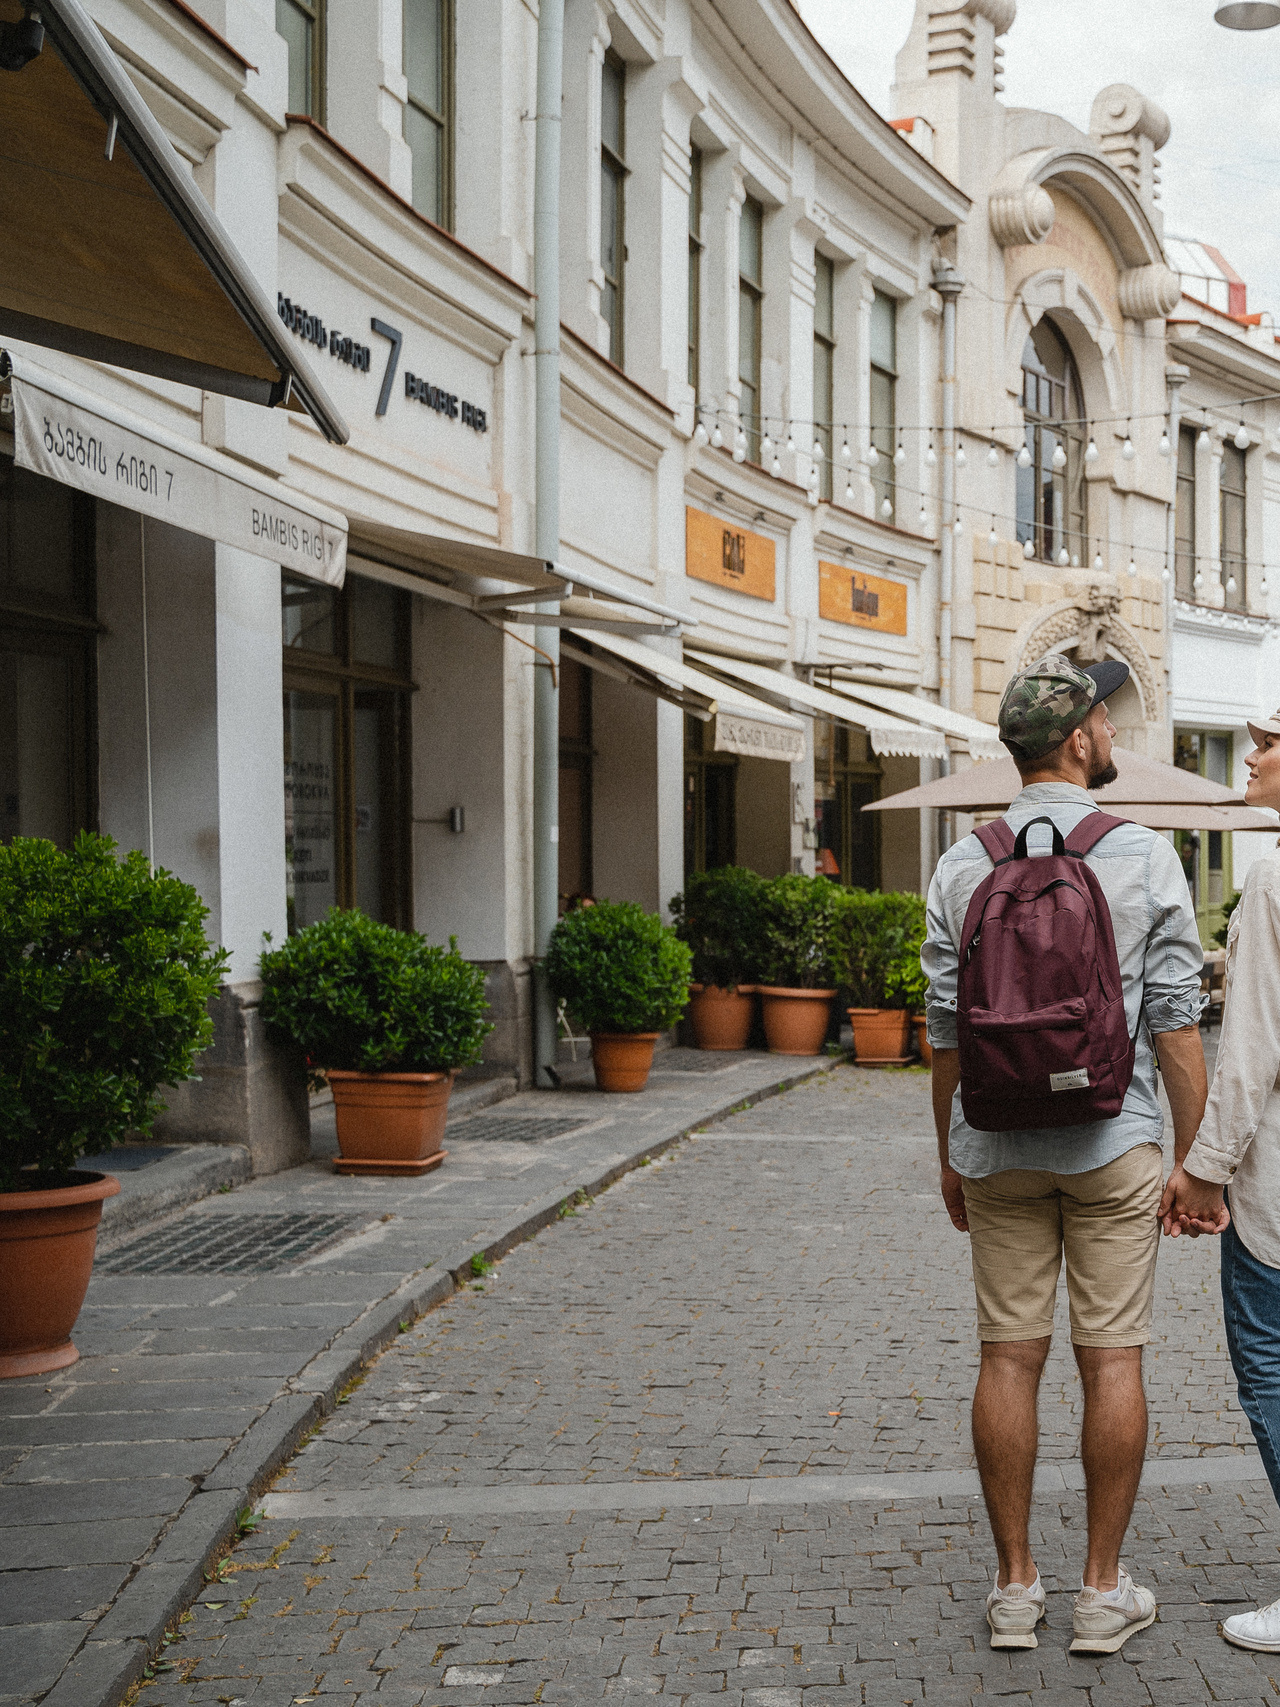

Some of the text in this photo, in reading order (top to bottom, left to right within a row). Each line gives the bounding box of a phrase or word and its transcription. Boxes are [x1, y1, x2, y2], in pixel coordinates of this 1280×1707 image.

[370, 317, 403, 416] 7
[404, 371, 487, 433] BAMBIS RIGI
[43, 416, 173, 501] ბამბის რიგი 7
[252, 508, 299, 551] BAMBIS
[1007, 1589, 1024, 1597] NIKE
[1081, 1591, 1097, 1600] NIKE
